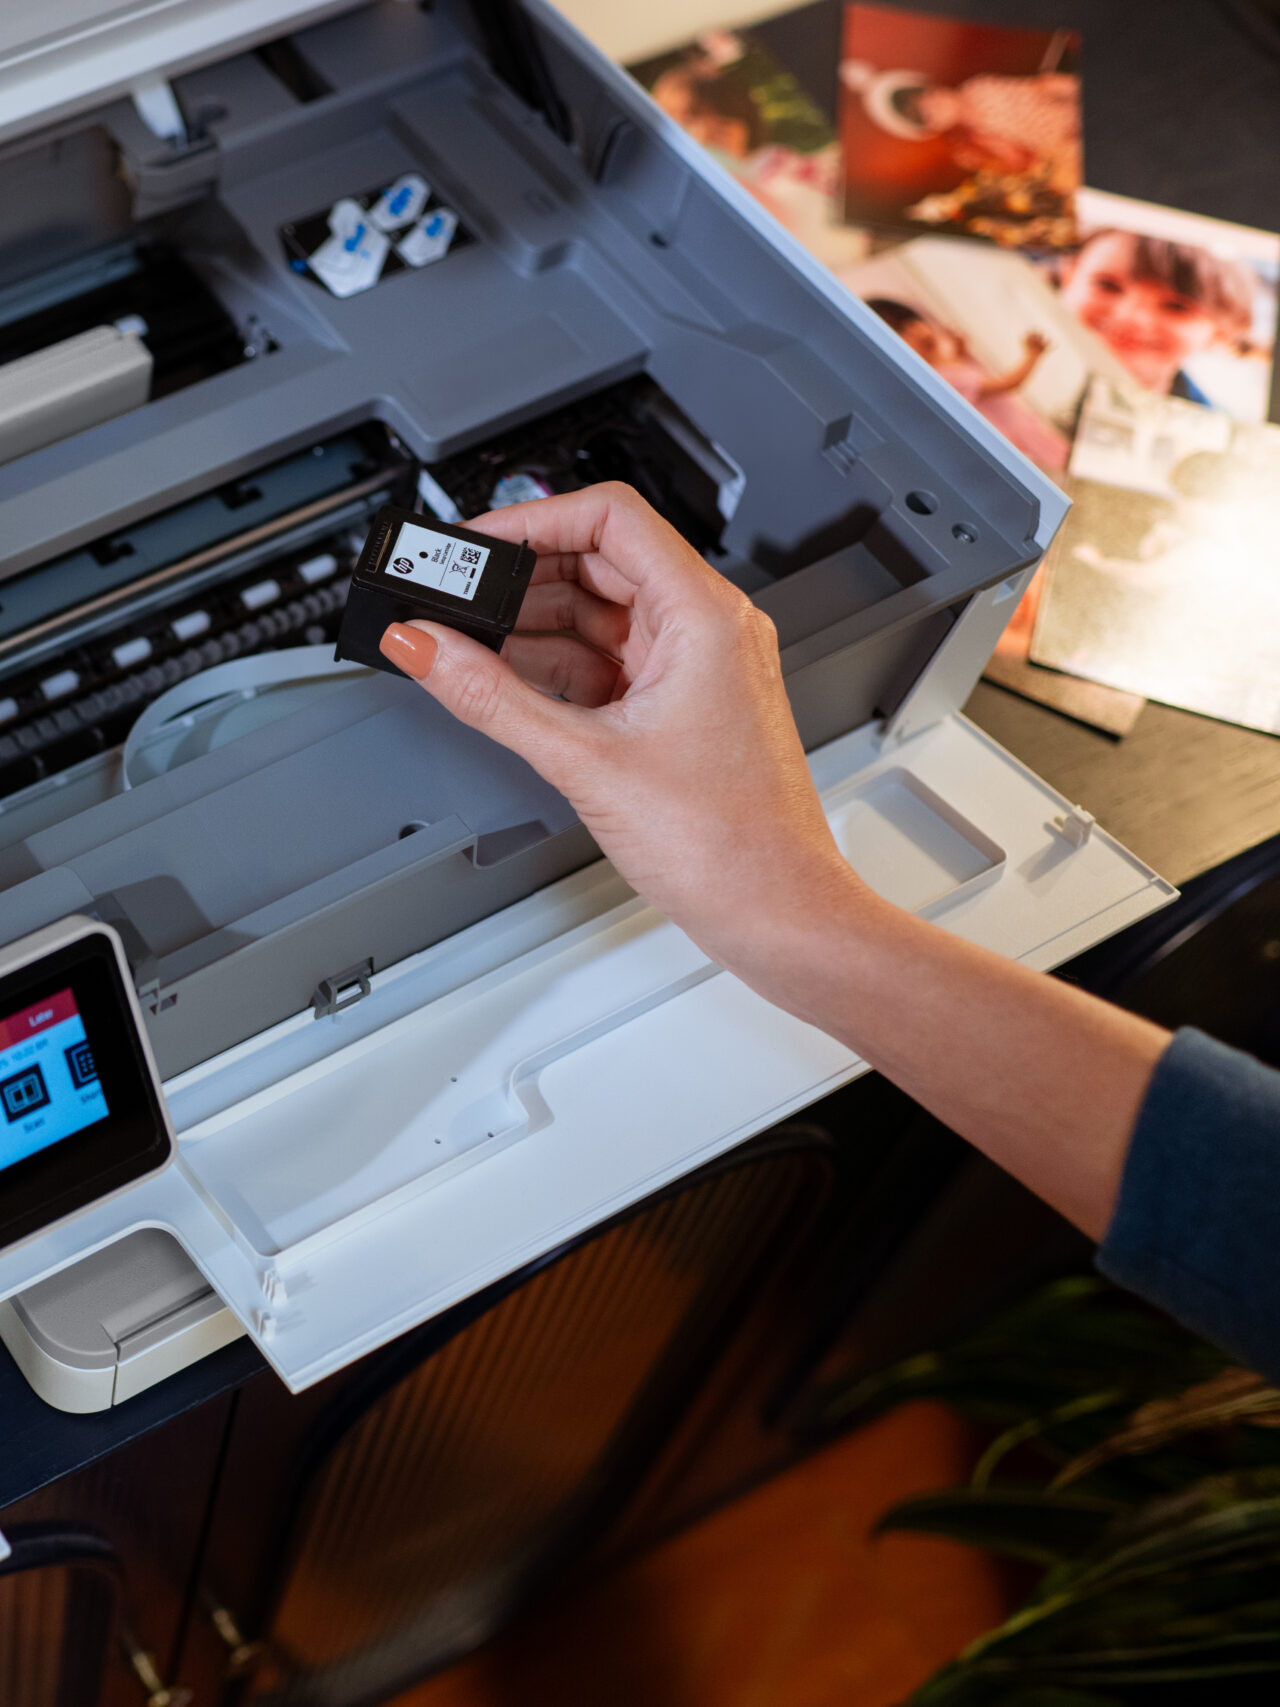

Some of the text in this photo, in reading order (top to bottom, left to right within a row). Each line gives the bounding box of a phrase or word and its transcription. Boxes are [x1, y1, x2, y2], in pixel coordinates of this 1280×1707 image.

[431, 548, 442, 563] Black
[393, 557, 414, 574] hp
[29, 1009, 53, 1027] Later
[23, 1117, 45, 1134] Scan
